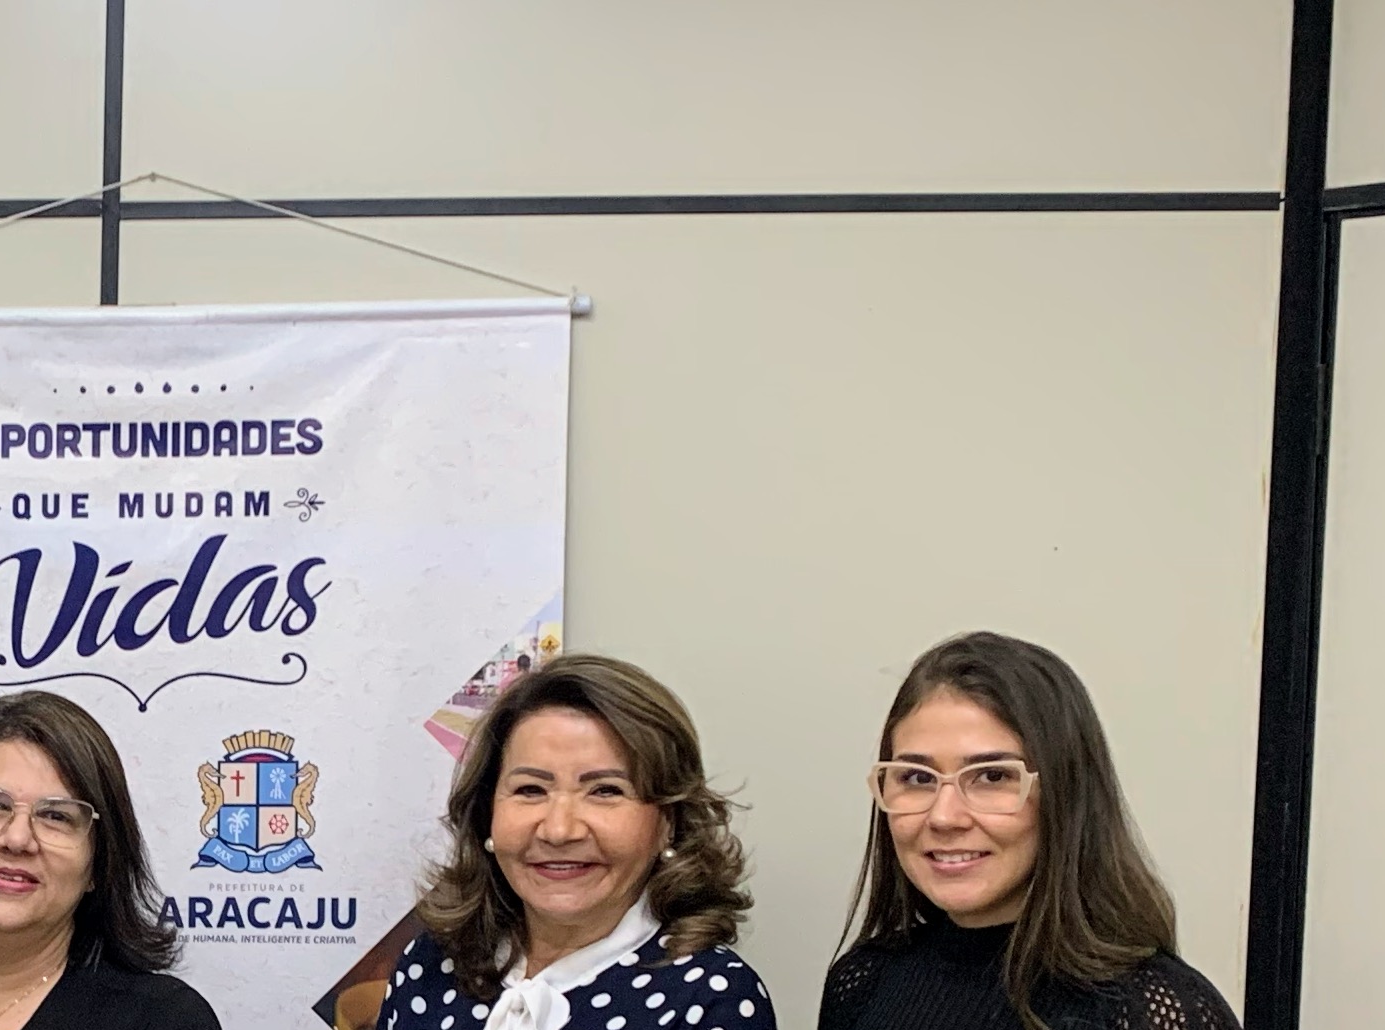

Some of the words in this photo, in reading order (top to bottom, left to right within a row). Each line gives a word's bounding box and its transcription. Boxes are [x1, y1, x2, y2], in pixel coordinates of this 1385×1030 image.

[12, 492, 90, 520] QUE
[118, 490, 270, 518] MUDAM
[213, 845, 234, 864] PAX
[249, 859, 263, 869] ET
[271, 843, 305, 867] LABOR
[209, 883, 284, 893] PREFEITURA
[290, 884, 305, 893] DE
[158, 896, 357, 930] ARACAJU
[241, 935, 301, 945] INTELIGENTE
[304, 935, 311, 944] E
[313, 935, 357, 945] CRIATIVA
